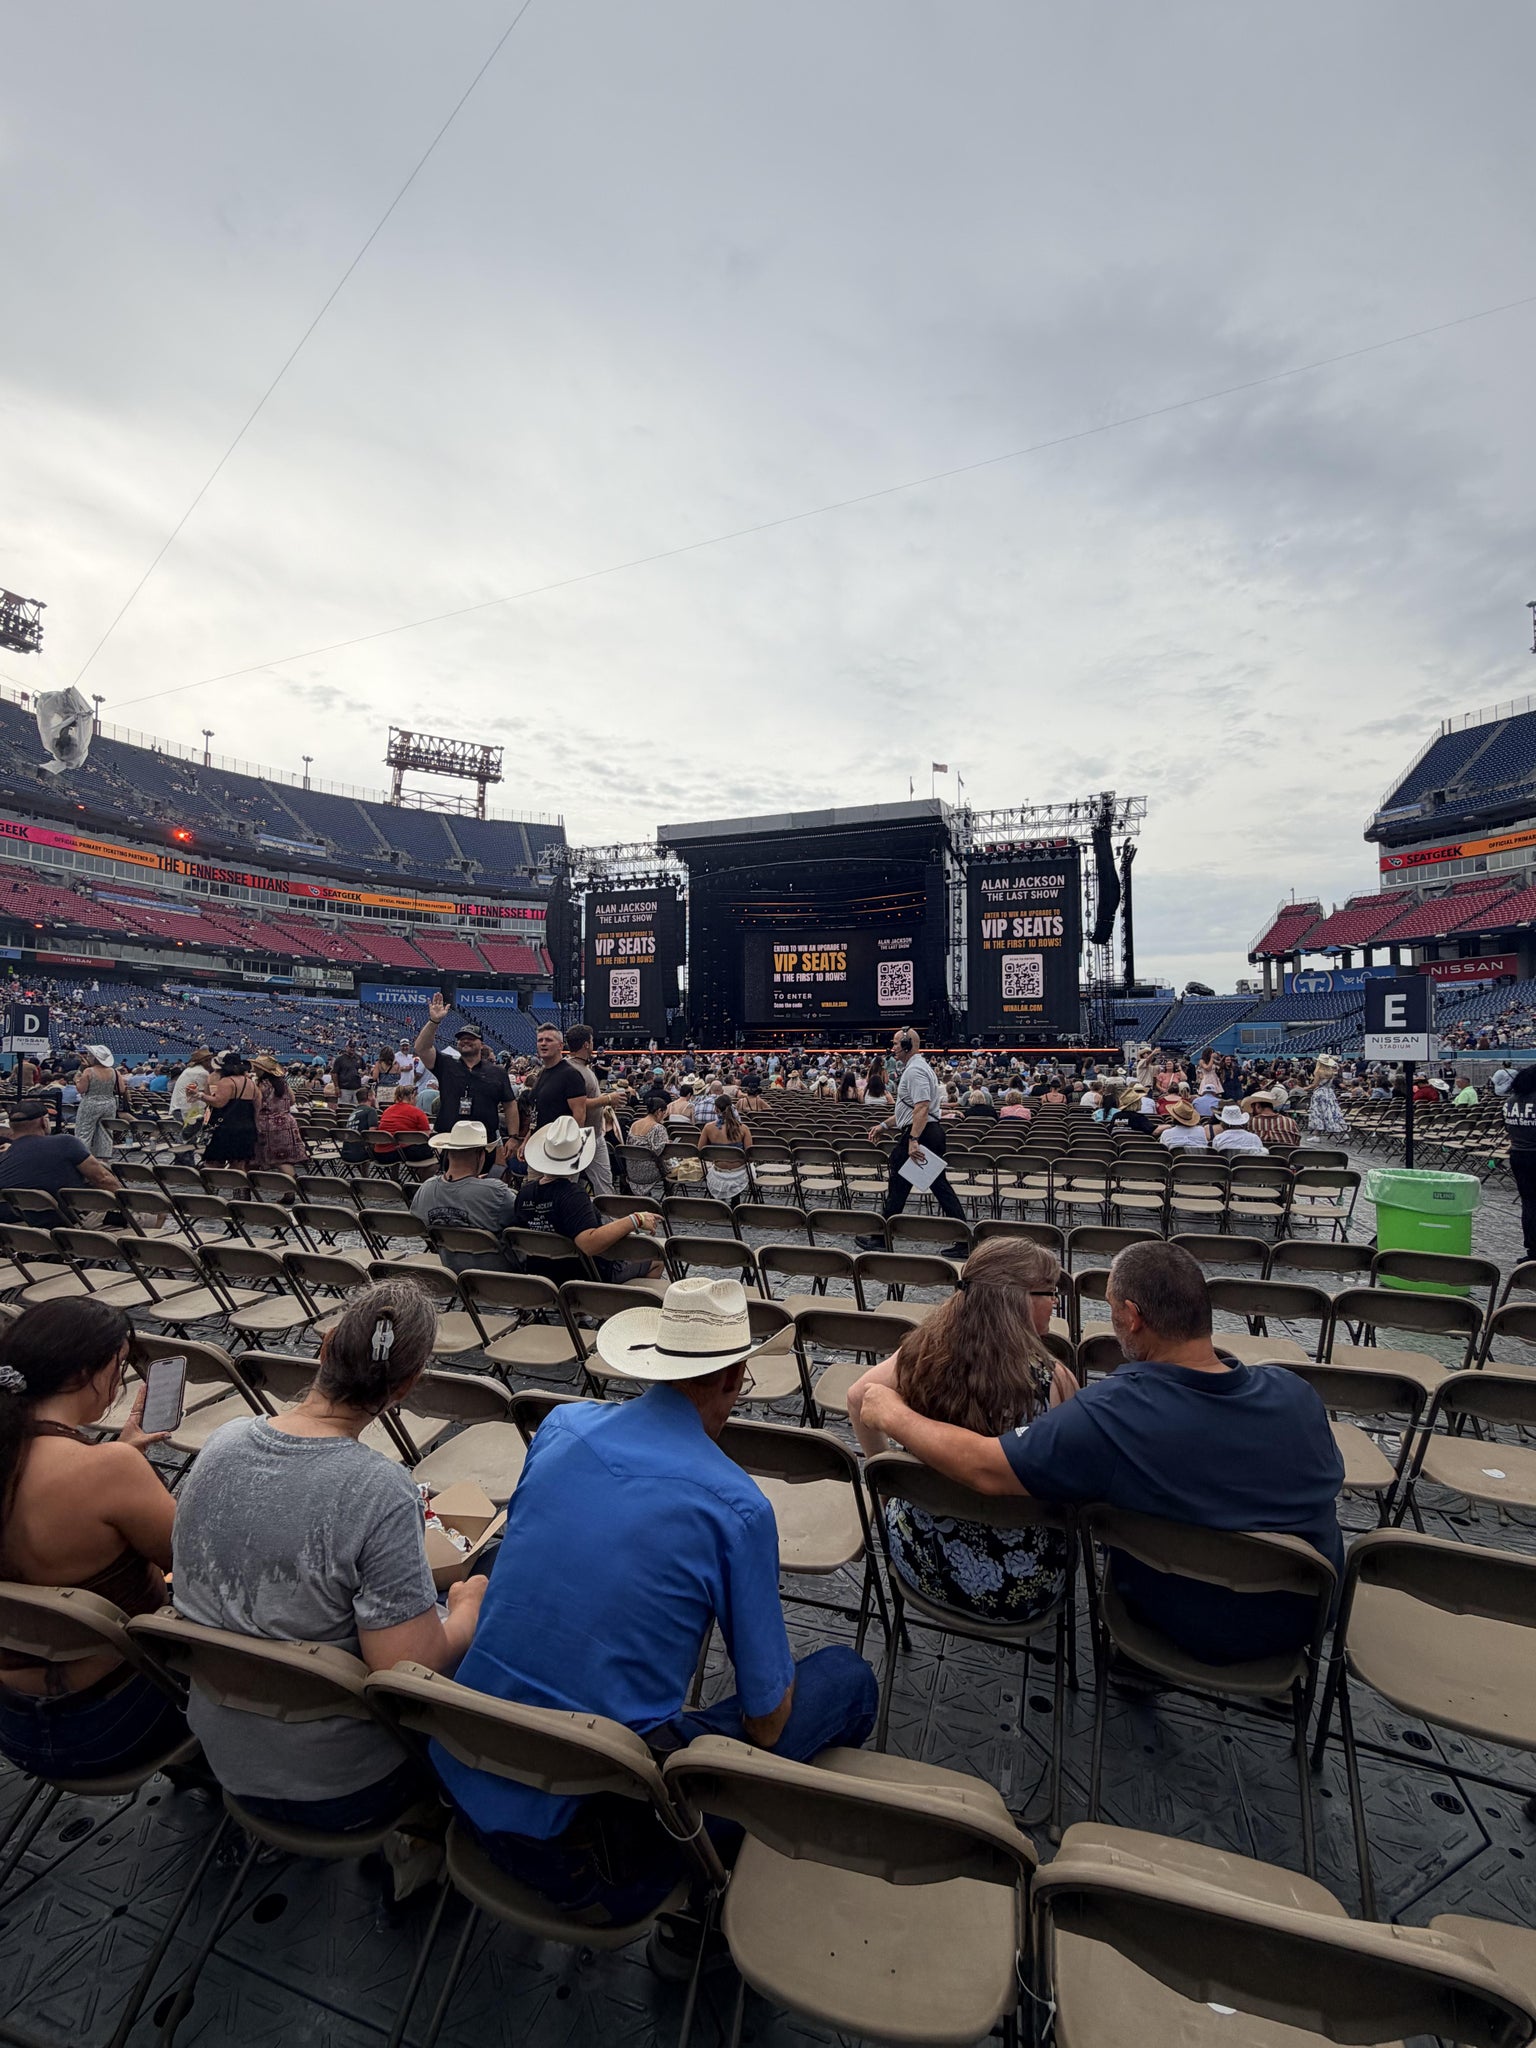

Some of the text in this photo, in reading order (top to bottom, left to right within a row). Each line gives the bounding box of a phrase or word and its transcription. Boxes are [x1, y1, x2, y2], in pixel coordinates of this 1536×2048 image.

[1488, 839, 1513, 849] OFFICIAL
[1406, 846, 1463, 865] SEATGEEK
[158, 857, 290, 893] THE TENNESSEE TITANS
[981, 874, 1065, 890] ALAN JACKSON
[322, 888, 362, 901] SEATGEEK
[987, 889, 1059, 902] THE LAST SHOW
[455, 903, 472, 915] THE
[474, 904, 528, 918] TENNESSEE
[595, 901, 658, 914] ALAN JACKSON
[600, 914, 653, 924] THE LAST SHOW
[981, 916, 1064, 938] VIP SEATS
[595, 936, 656, 956] VIP SEATS
[798, 944, 808, 952] WIN
[809, 944, 816, 952] AN
[984, 938, 1062, 950] IN THE FIRST 10 ROWS!
[603, 957, 612, 965] THE
[630, 956, 636, 964] 10
[774, 952, 847, 972] VIP SEATS
[1431, 960, 1504, 975] NISSAN
[773, 972, 847, 982] IN THE FIRST 10 ROWS!
[376, 992, 427, 1003] TITANS
[460, 995, 514, 1004] NISSAN
[1385, 994, 1407, 1027] E
[24, 1014, 40, 1033] D
